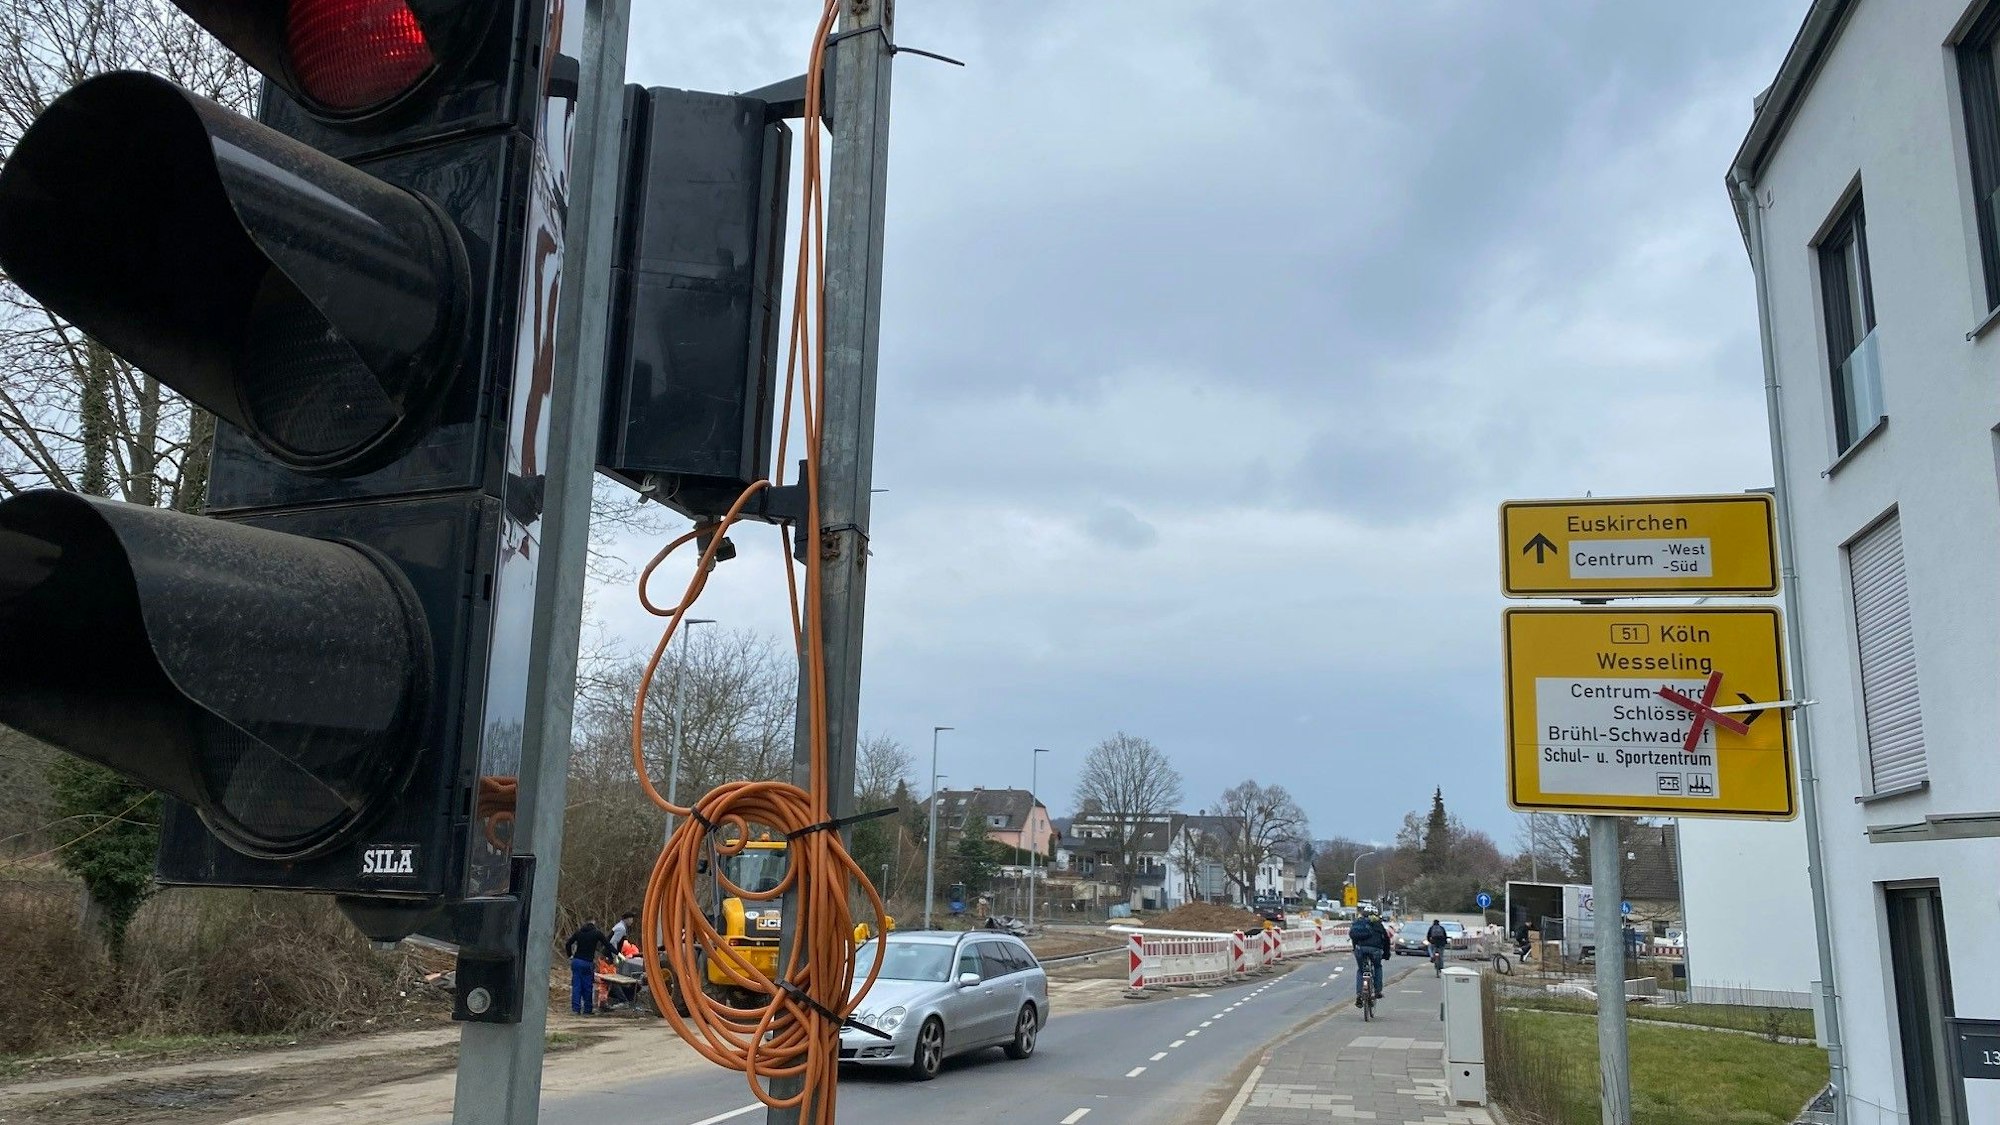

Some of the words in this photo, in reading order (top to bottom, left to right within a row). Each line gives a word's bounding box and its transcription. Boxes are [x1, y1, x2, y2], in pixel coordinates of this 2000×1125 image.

[1568, 515, 1688, 532] Euskirchen
[1662, 544, 1706, 555] -West
[1575, 553, 1654, 566] Centrum
[1663, 561, 1699, 572] -Süd
[1622, 627, 1639, 641] 51
[1661, 625, 1710, 643] Köln
[1597, 652, 1713, 675] Wesseling
[1571, 683, 1706, 699] Centrum-ord
[1544, 748, 1590, 763] Schul-
[1597, 752, 1609, 764] u.
[1616, 749, 1712, 768] Sportzentrum
[363, 849, 414, 873] SILA
